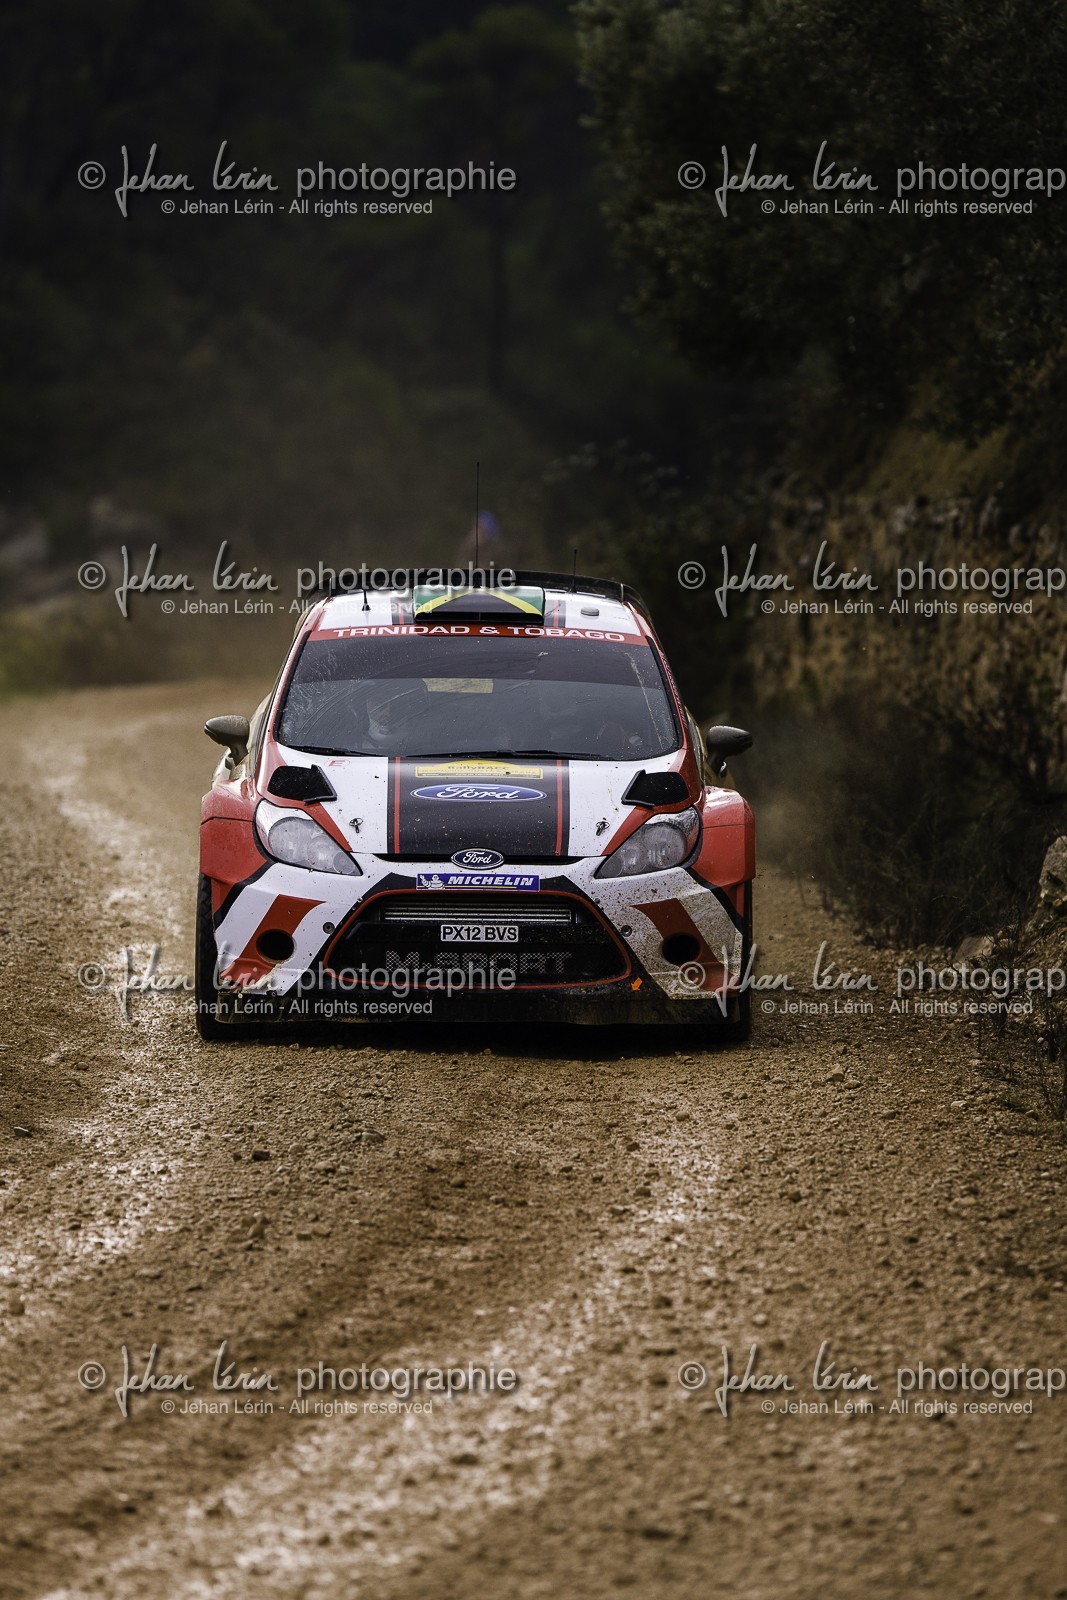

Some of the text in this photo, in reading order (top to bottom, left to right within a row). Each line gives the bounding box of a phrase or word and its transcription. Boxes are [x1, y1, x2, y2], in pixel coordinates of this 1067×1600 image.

[332, 625, 625, 642] TRINIDAD & TOBAGO
[436, 785, 520, 800] Ford
[462, 851, 493, 865] Ford
[447, 875, 535, 886] MICHELIN
[442, 926, 518, 941] PX12 BVS
